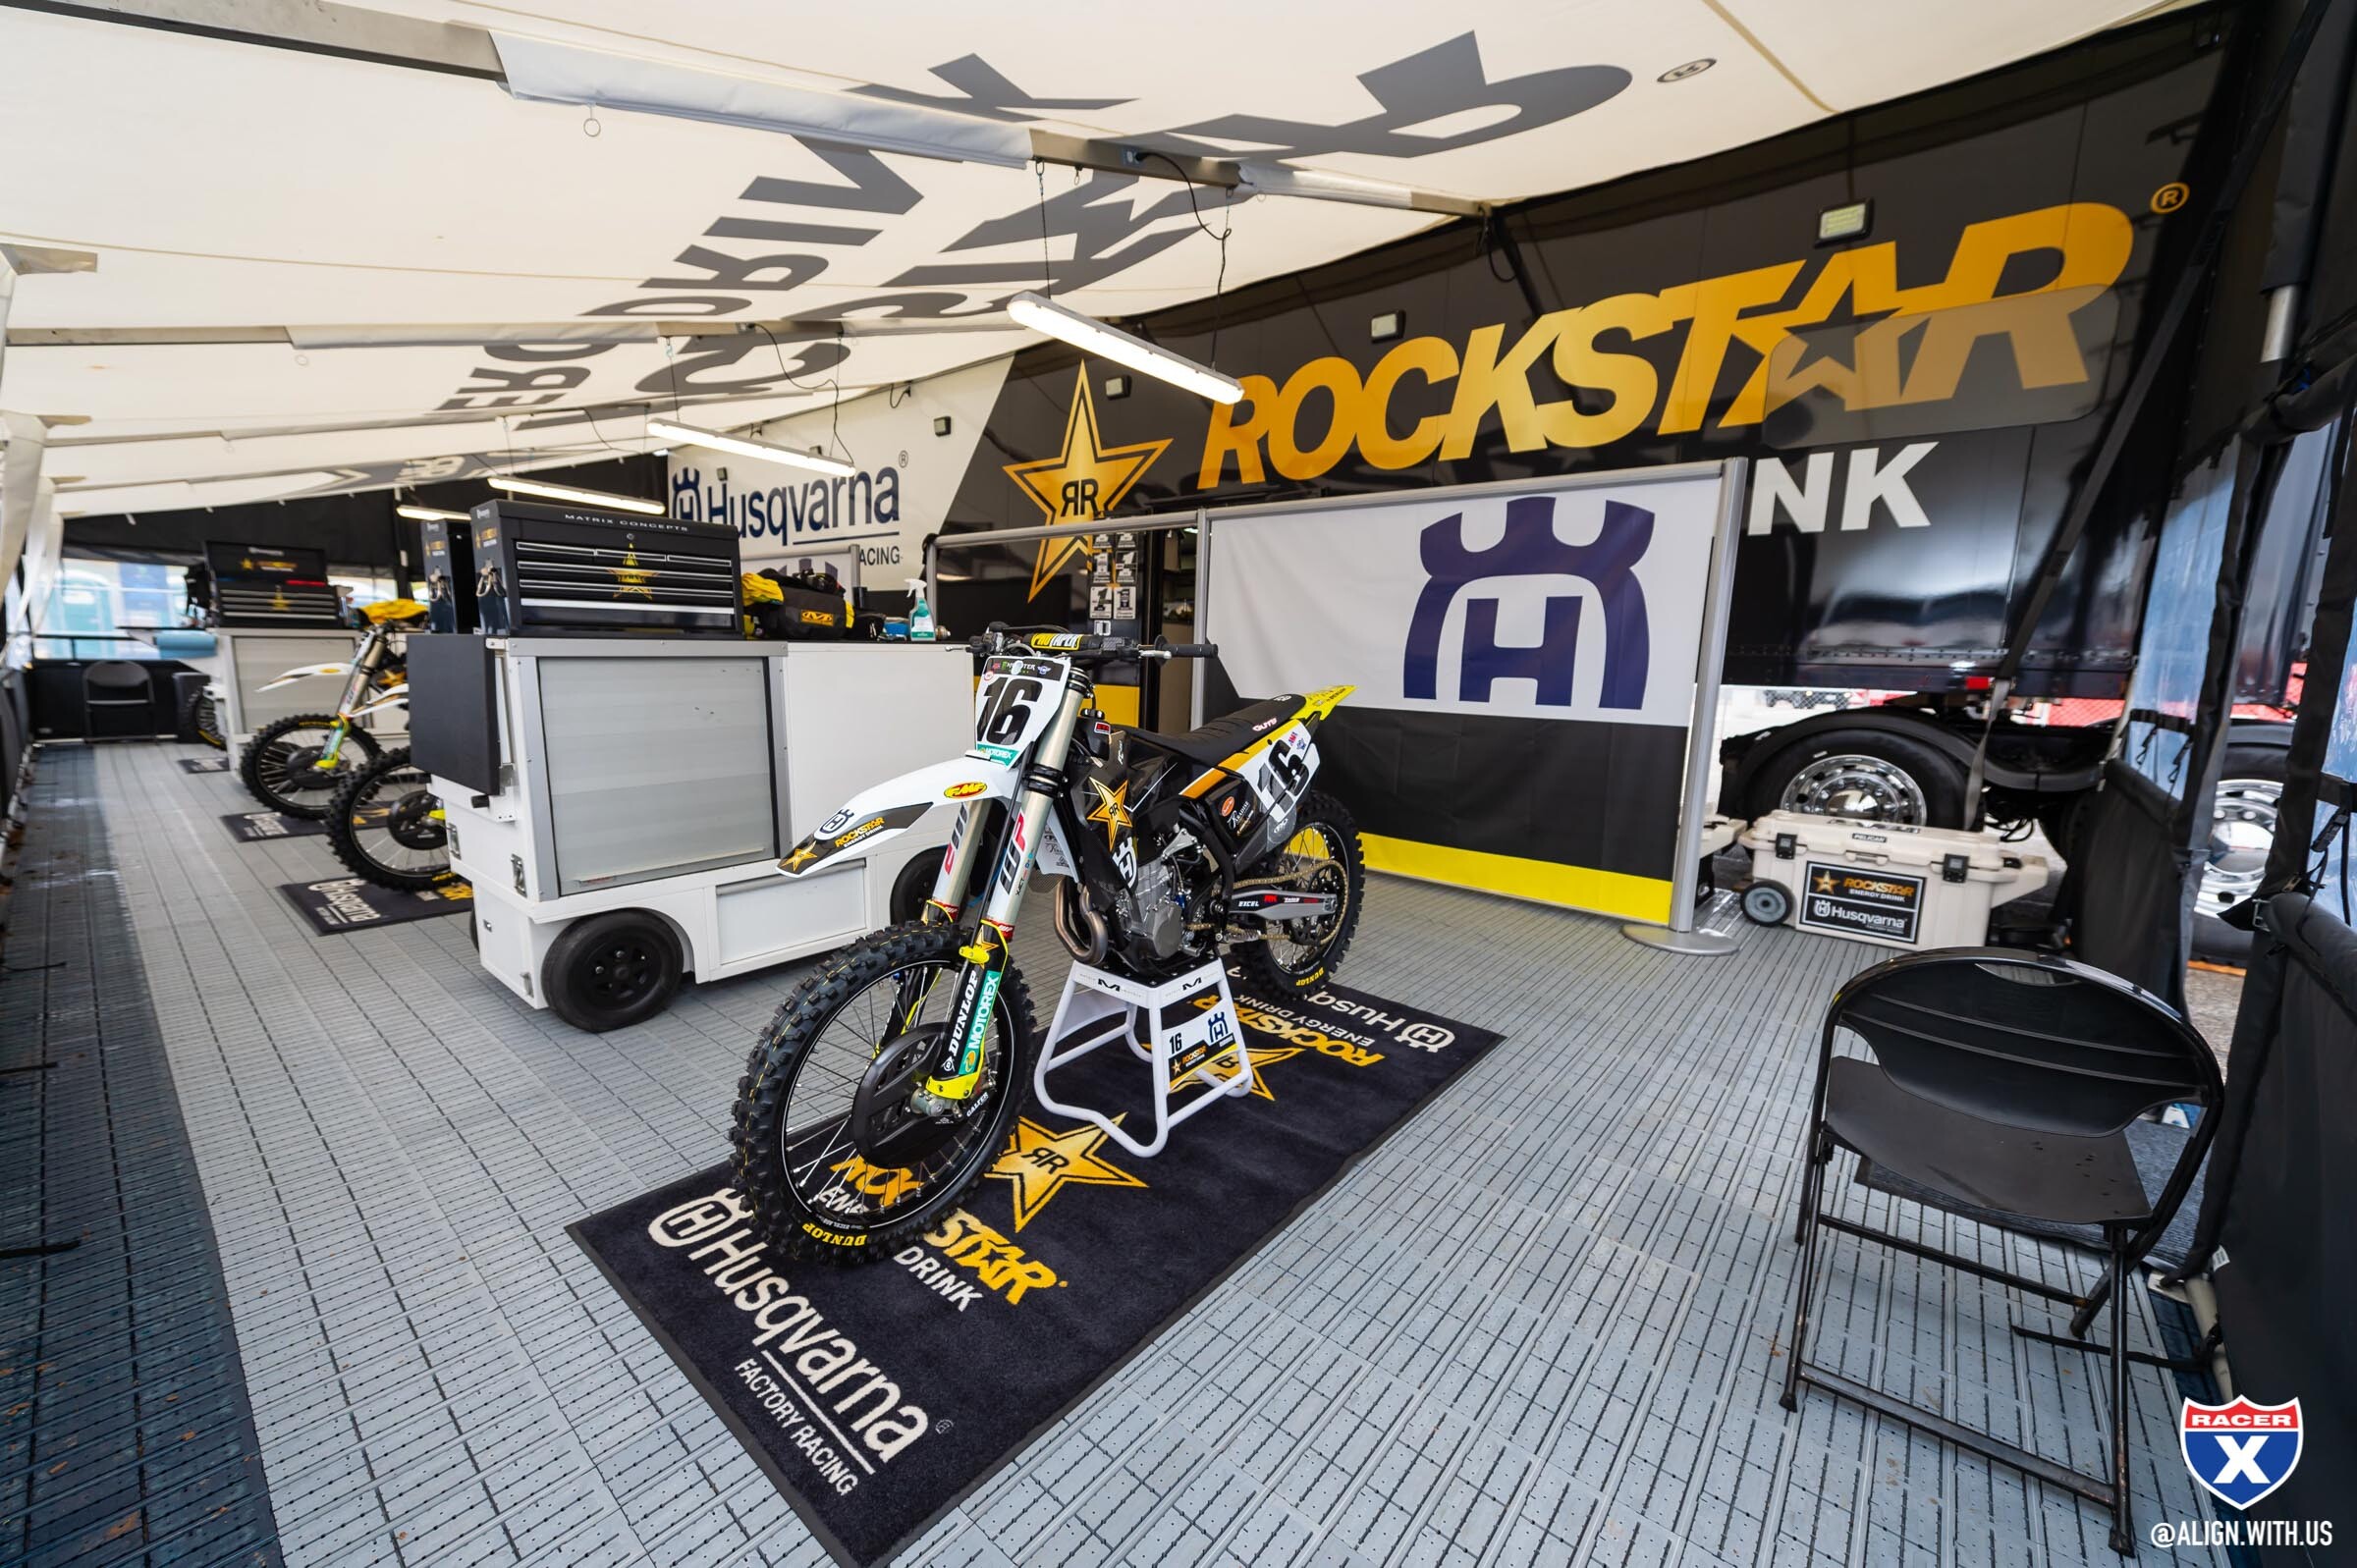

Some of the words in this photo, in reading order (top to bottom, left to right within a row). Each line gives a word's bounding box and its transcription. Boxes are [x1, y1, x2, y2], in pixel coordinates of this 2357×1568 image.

[1198, 202, 2134, 489] ROCKSTAR
[708, 466, 900, 546] Husqvarna
[565, 514, 614, 524] MATRIX
[620, 519, 688, 532] CONCEPTS
[860, 546, 901, 566] ACING
[976, 676, 1043, 746] 16
[1257, 739, 1311, 813] 16
[946, 783, 986, 797] FMF
[834, 817, 886, 848] ROCKSTAR
[844, 834, 866, 848] ENERGY
[1853, 834, 1886, 843] PELICAN
[1843, 877, 1915, 896] ROCKSTAR
[1848, 889, 1880, 899] ENERGY
[1880, 892, 1905, 902] DRINK
[1832, 904, 1905, 928] Husqvarna
[1295, 966, 1326, 987] DUNLOP
[948, 969, 980, 1057] DUNLOP
[968, 975, 1000, 1051] MOTOREX
[1233, 994, 1296, 1019] DRINK
[1169, 1032, 1182, 1054] 16
[1291, 1013, 1376, 1048] ENERGY
[966, 1091, 989, 1118] GALFER
[801, 1221, 867, 1247] DUNLOP
[892, 1245, 983, 1313] DRINK
[687, 1226, 929, 1464] Husqvarna
[735, 1358, 802, 1431] FACTORY
[791, 1421, 859, 1497] RACING
